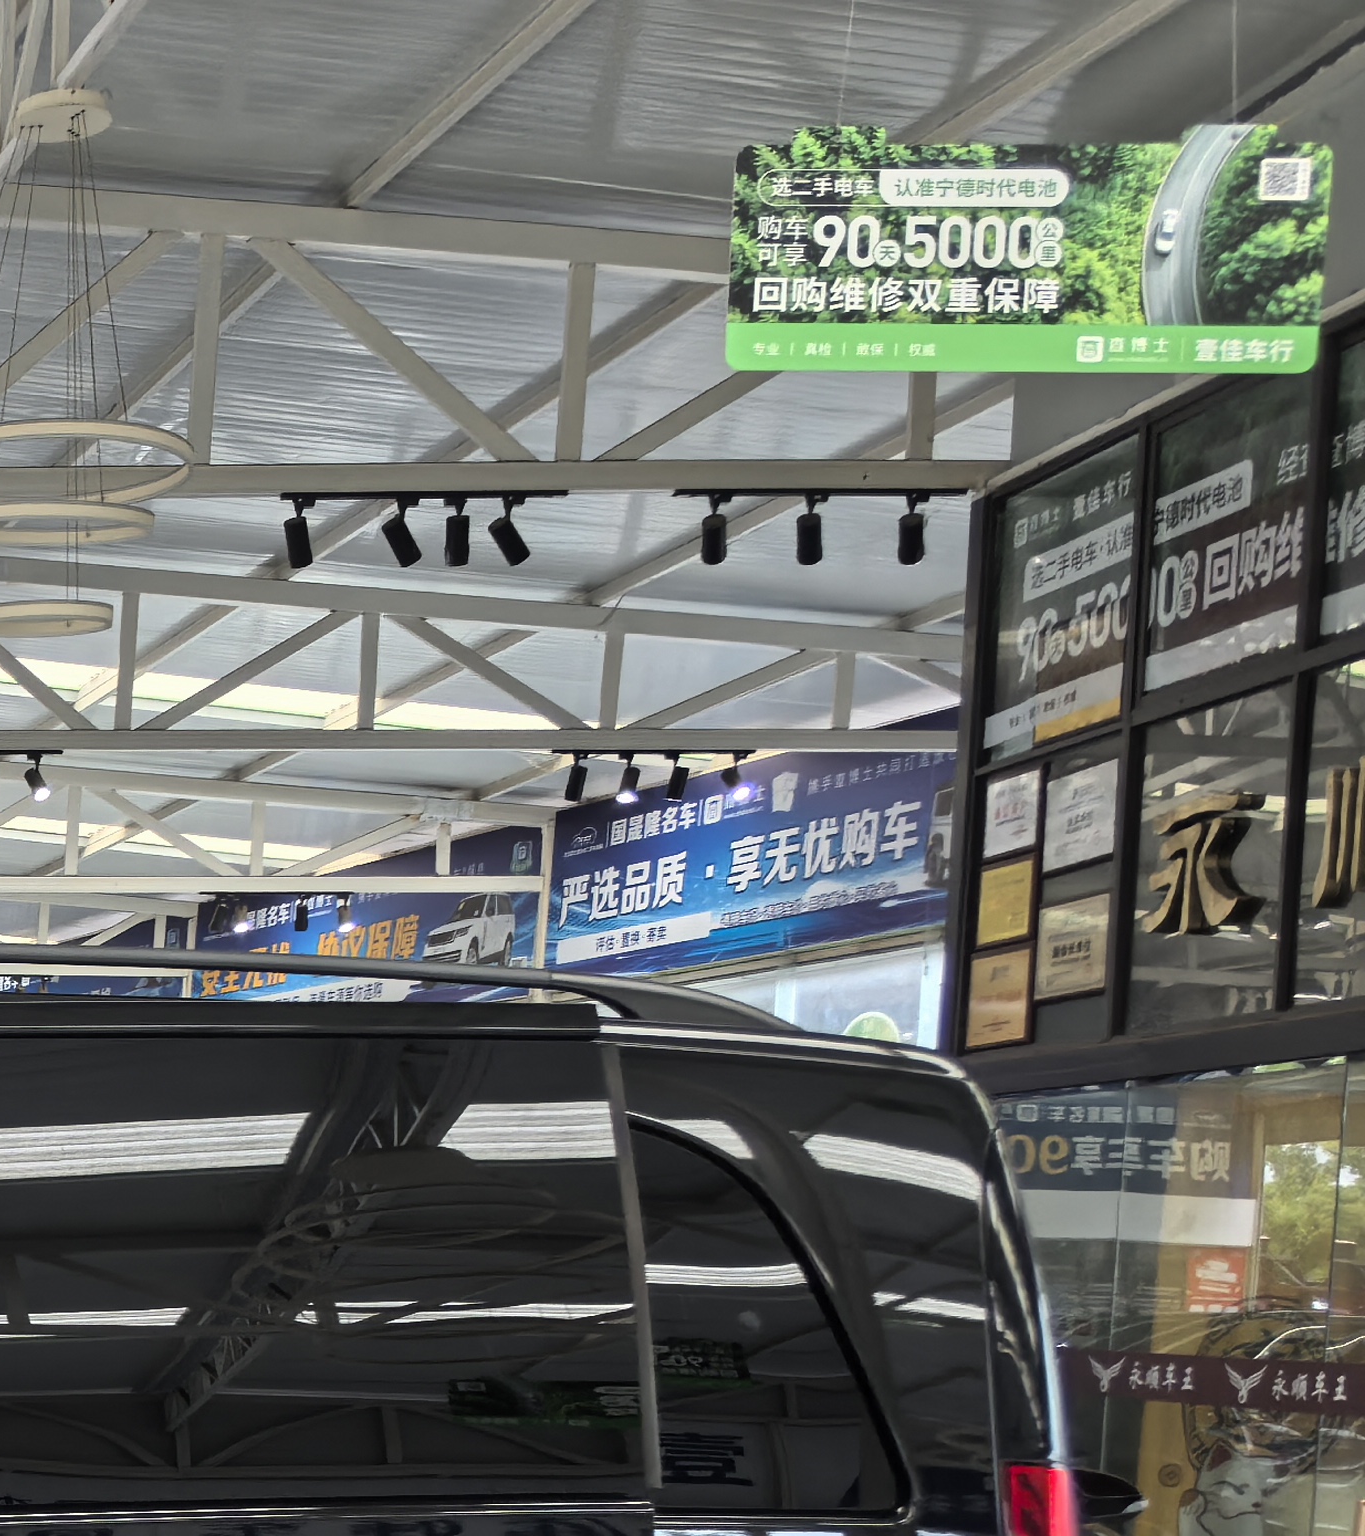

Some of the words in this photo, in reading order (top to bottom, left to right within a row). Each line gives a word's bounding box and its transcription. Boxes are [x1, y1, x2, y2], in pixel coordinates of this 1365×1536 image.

[770, 177, 874, 198] 选二手电车
[894, 177, 1057, 199] 认准宁德时代电池
[757, 215, 808, 239] 购车
[757, 243, 808, 266] 可享
[751, 277, 1060, 314] 回购维修双重保障
[557, 851, 687, 931] 严选品质
[725, 800, 923, 894] 享无忧购车
